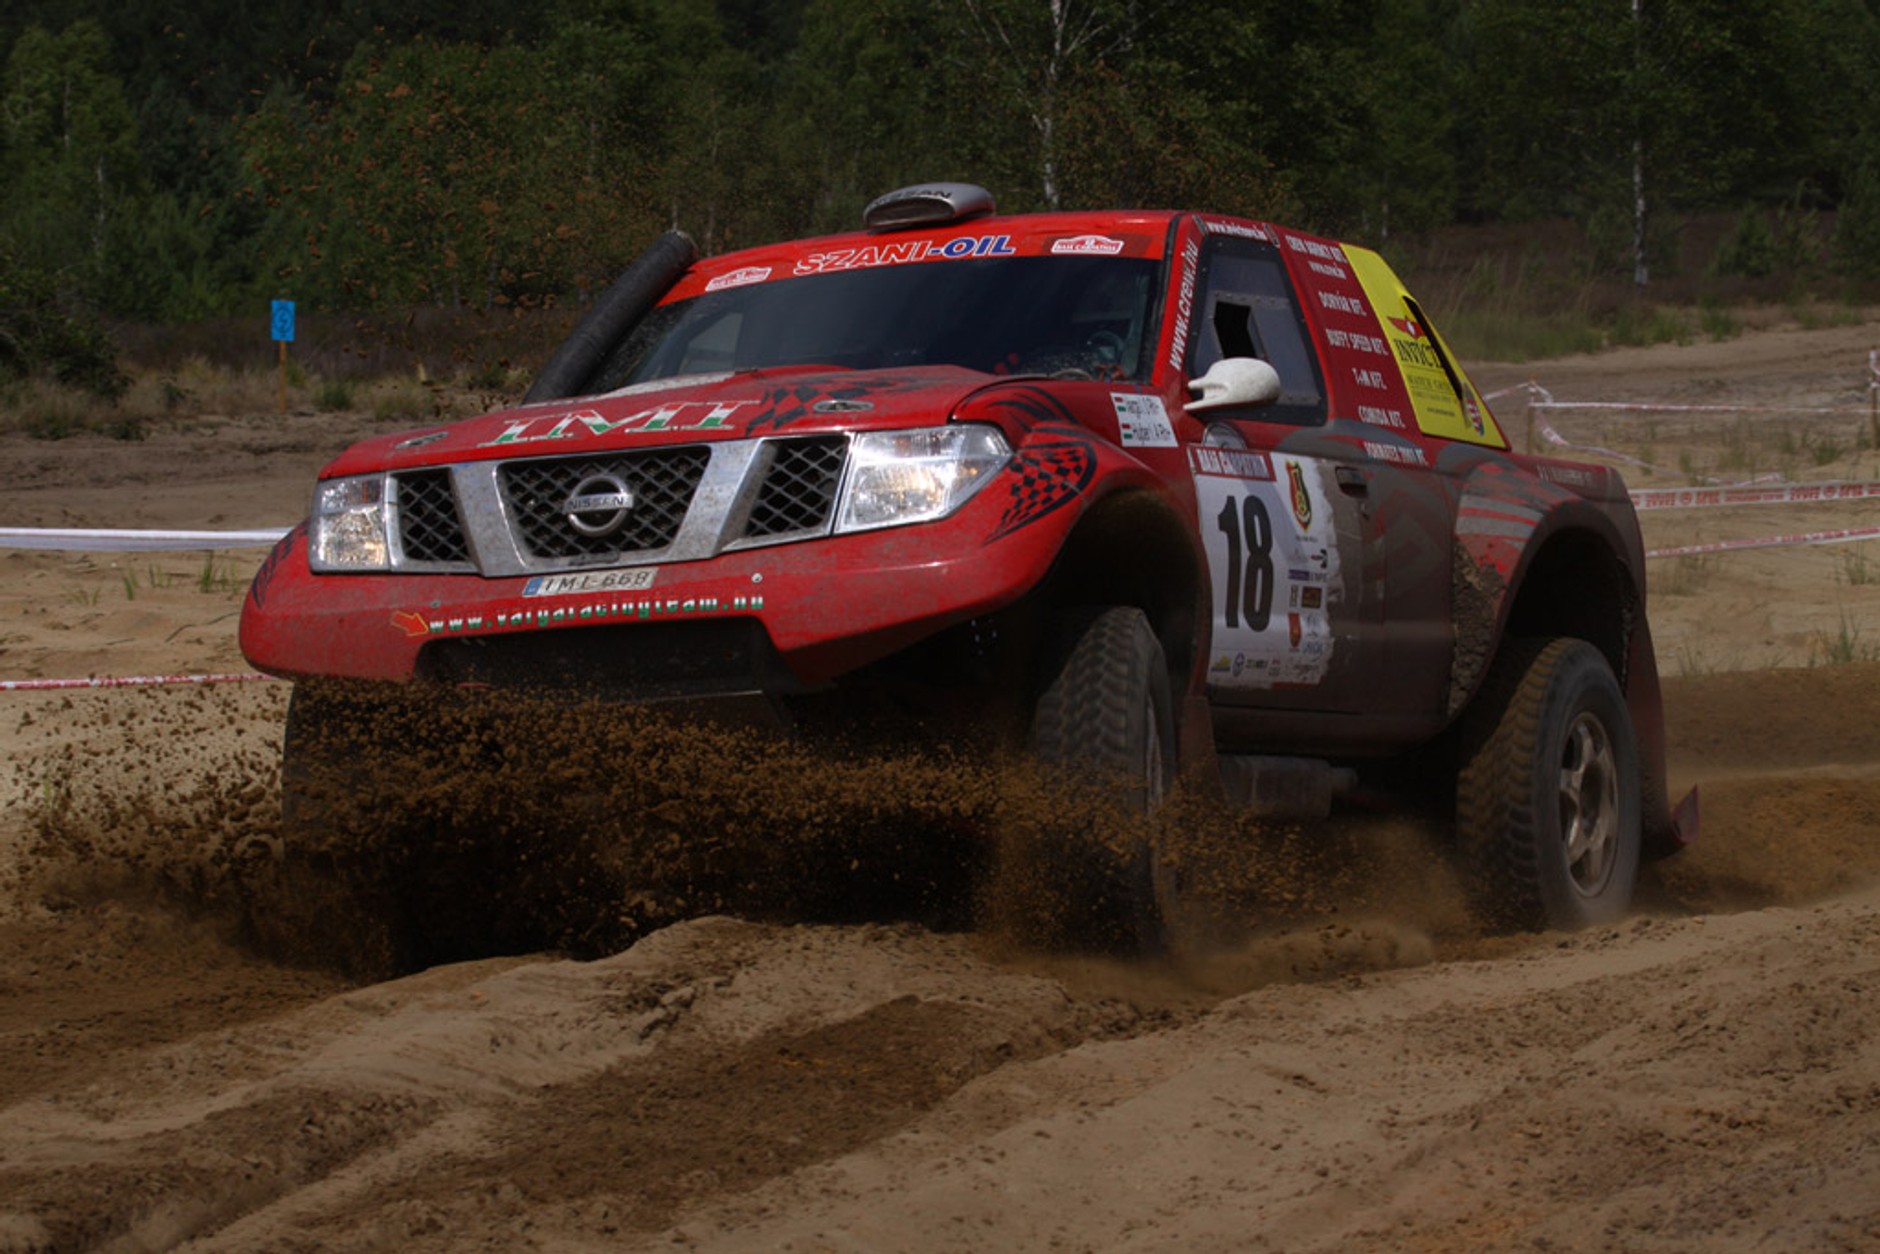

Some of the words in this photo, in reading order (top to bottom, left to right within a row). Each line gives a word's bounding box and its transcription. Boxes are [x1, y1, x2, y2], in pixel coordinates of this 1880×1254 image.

[793, 234, 1017, 277] SZANI-OIL
[1169, 238, 1199, 371] www.crew.hu
[568, 496, 625, 511] NISSAN
[1217, 494, 1274, 632] 18
